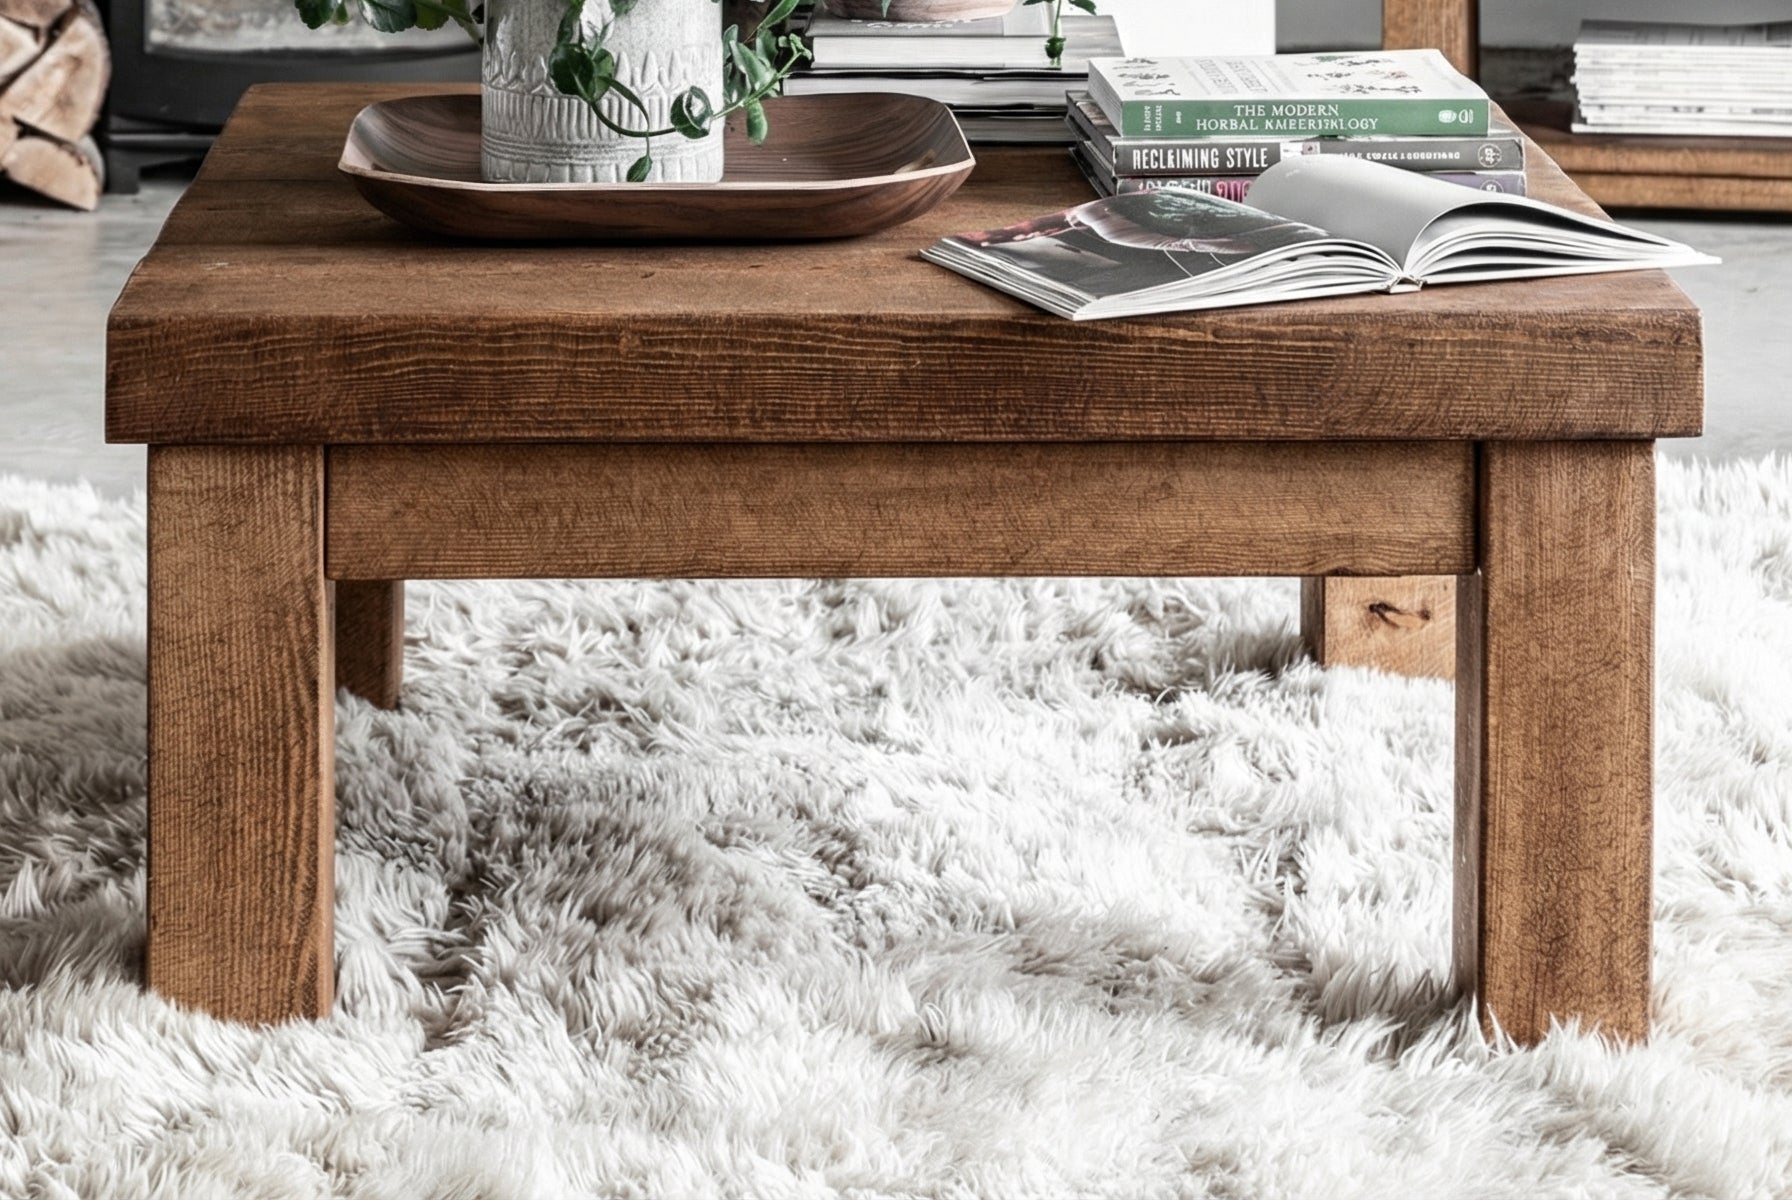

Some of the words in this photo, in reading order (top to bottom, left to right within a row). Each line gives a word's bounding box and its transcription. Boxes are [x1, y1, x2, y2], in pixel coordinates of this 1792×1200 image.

[1233, 104, 1266, 117] THE
[1271, 103, 1339, 117] MODERN
[1196, 118, 1259, 131] HORBAL
[1226, 147, 1269, 169] STYLE
